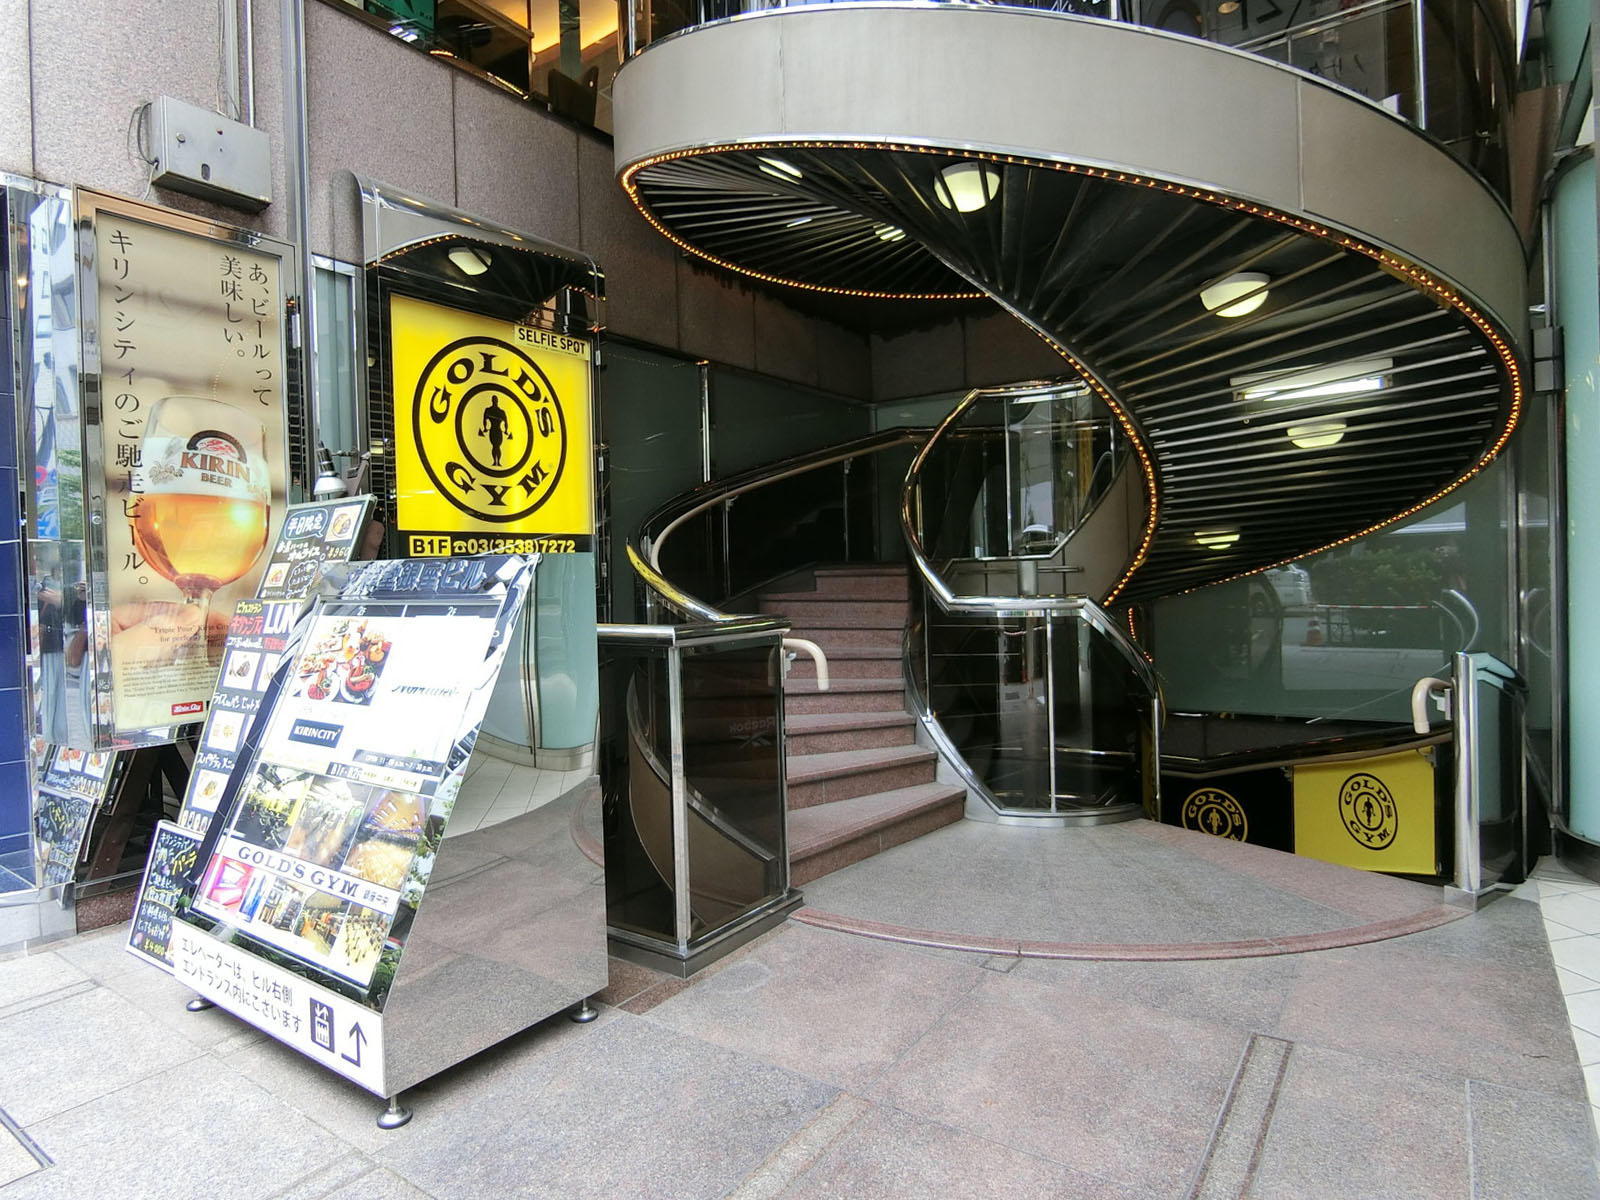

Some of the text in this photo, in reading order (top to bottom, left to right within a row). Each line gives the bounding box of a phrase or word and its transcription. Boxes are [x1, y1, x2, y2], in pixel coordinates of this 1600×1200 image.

[219, 254, 246, 358] 美味しい。
[248, 263, 273, 406] あ、ビールって
[518, 327, 558, 348] SELFIE
[560, 337, 586, 355] SPOT
[109, 229, 149, 585] キリンシティのご馳走ビール。
[428, 351, 556, 438] GOLD'S
[180, 451, 250, 483] KIRIN
[201, 472, 233, 488] BEER
[444, 460, 551, 507] GYM
[412, 538, 576, 555] B1F 03(3538)7272
[1188, 793, 1242, 826] GOLD'S
[1344, 779, 1393, 818] GOLD'S
[1350, 820, 1391, 843] GYM
[237, 846, 306, 879] GOLD'S
[310, 870, 360, 898] GYM
